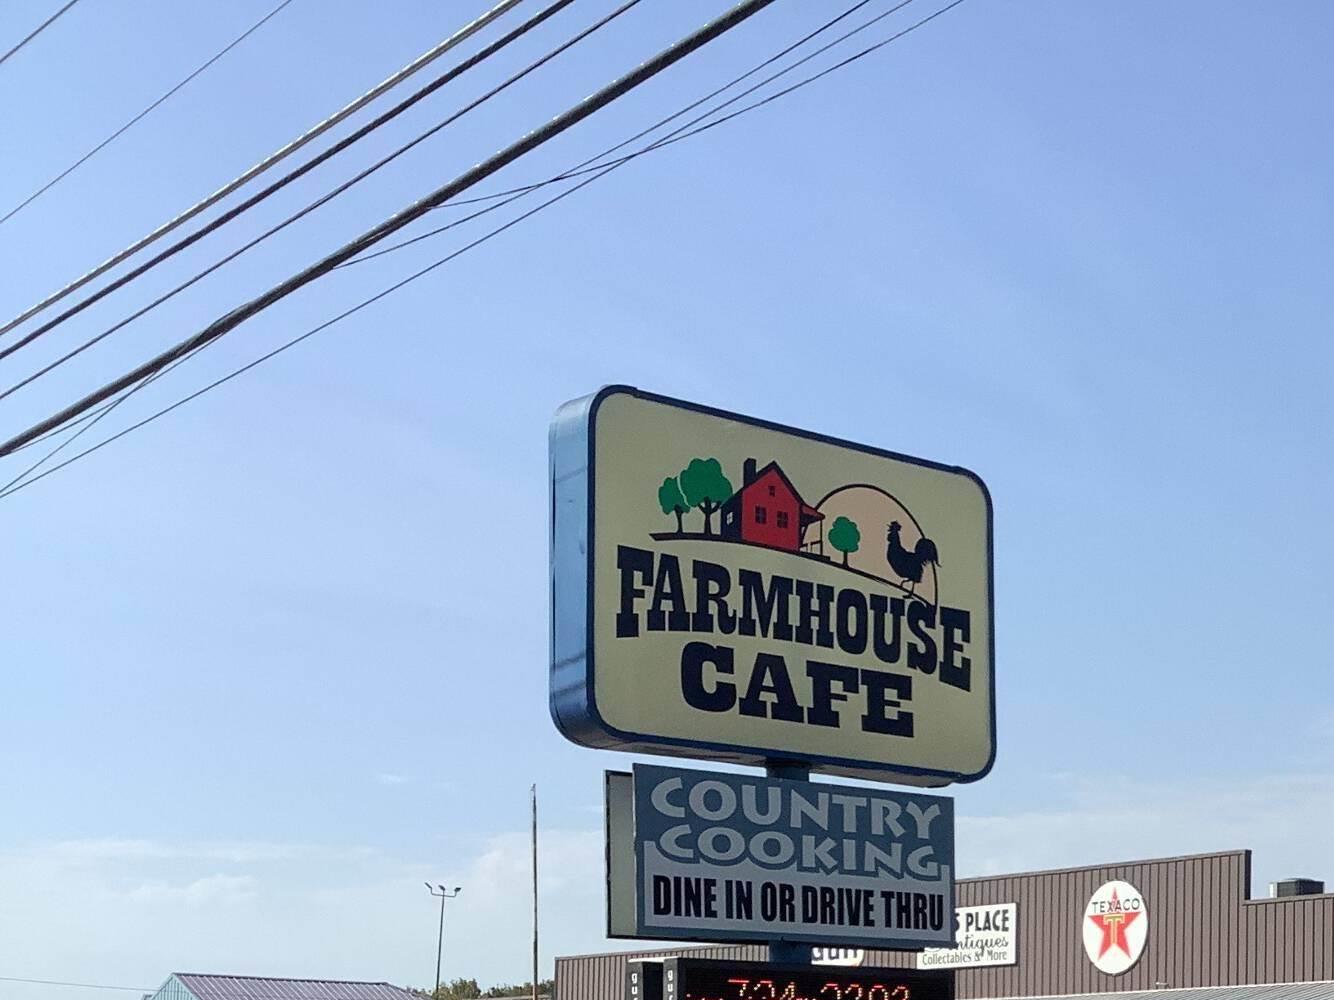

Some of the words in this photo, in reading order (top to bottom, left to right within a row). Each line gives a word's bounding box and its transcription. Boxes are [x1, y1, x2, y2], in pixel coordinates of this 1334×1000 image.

[616, 545, 971, 692] FARMHOUSE
[681, 641, 914, 738] CAFE
[650, 777, 941, 839] COUNTRY
[659, 824, 940, 878] COOKING
[653, 875, 718, 918] DINE
[725, 879, 753, 921] IN
[761, 881, 795, 923] OR
[802, 885, 875, 928] DRIVE
[880, 891, 944, 931] THRU
[965, 909, 1009, 932] PLACE
[1091, 898, 1140, 913] TEXACO
[1103, 913, 1125, 944] T
[922, 951, 971, 966] Collectables
[986, 950, 1007, 961] More
